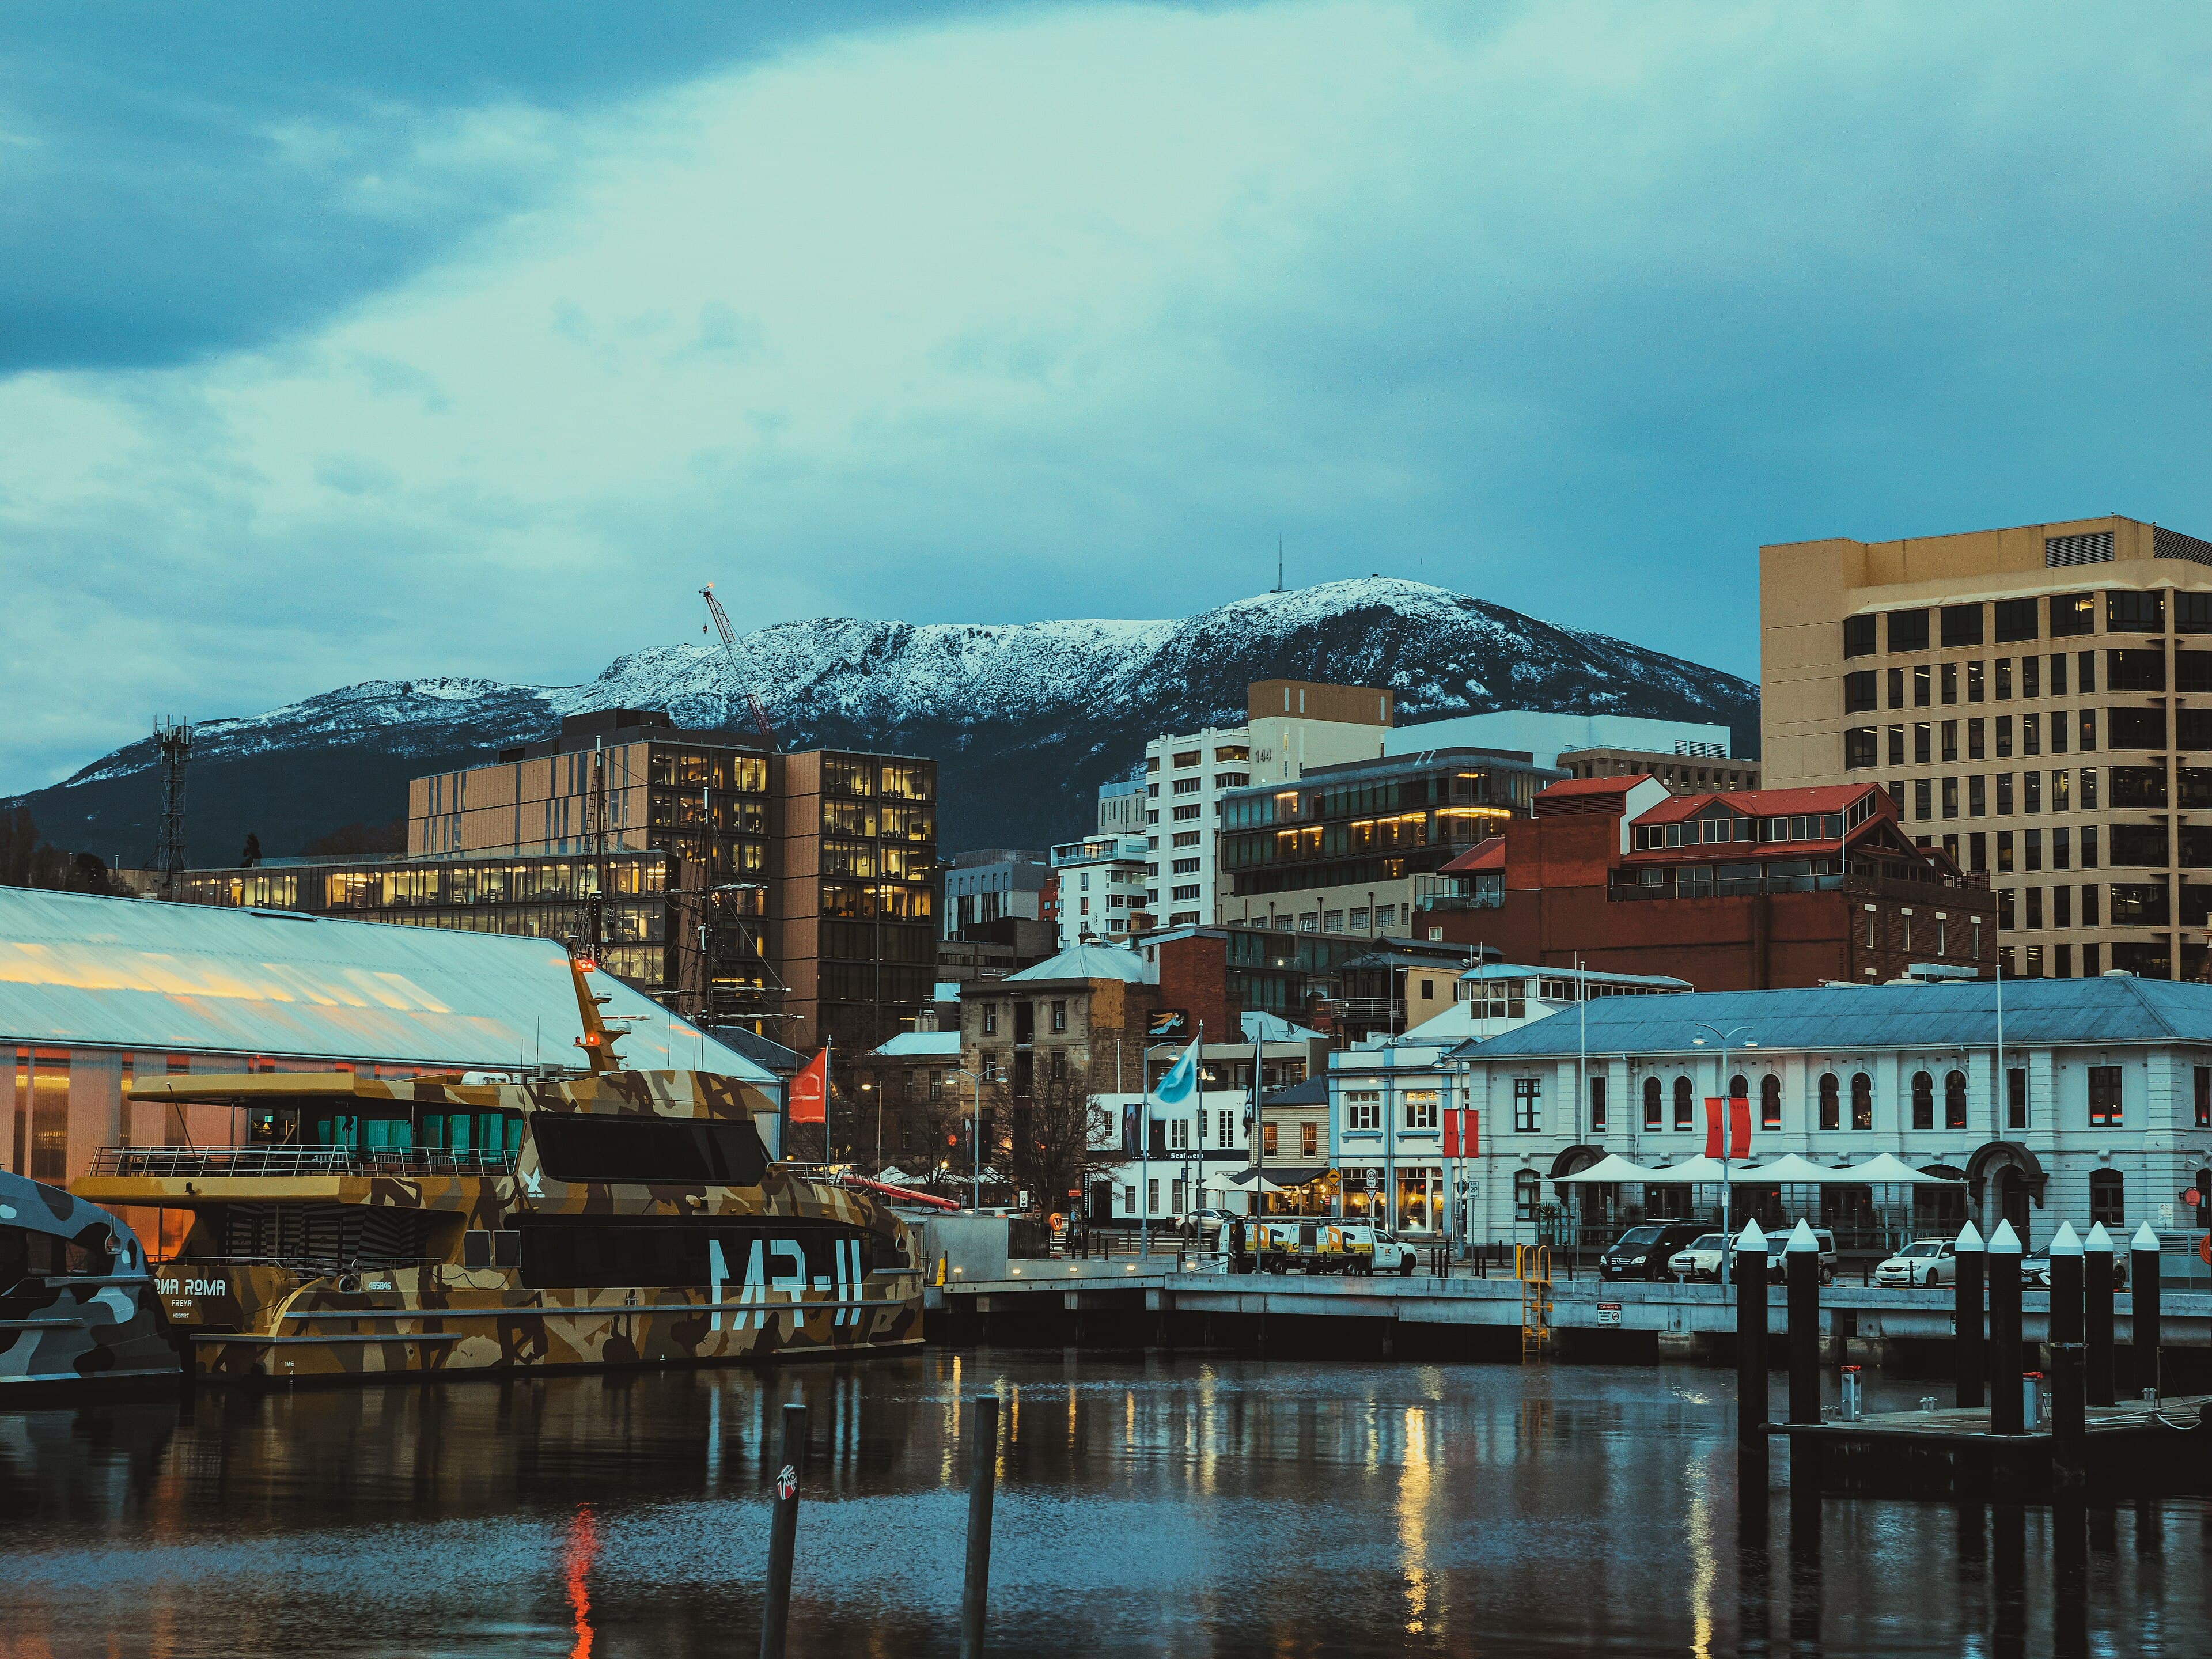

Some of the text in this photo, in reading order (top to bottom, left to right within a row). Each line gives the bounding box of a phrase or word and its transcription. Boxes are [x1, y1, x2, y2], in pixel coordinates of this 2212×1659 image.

[1256, 748, 1271, 763] 144
[185, 1279, 225, 1296] ROMA
[369, 1282, 391, 1290] 455846
